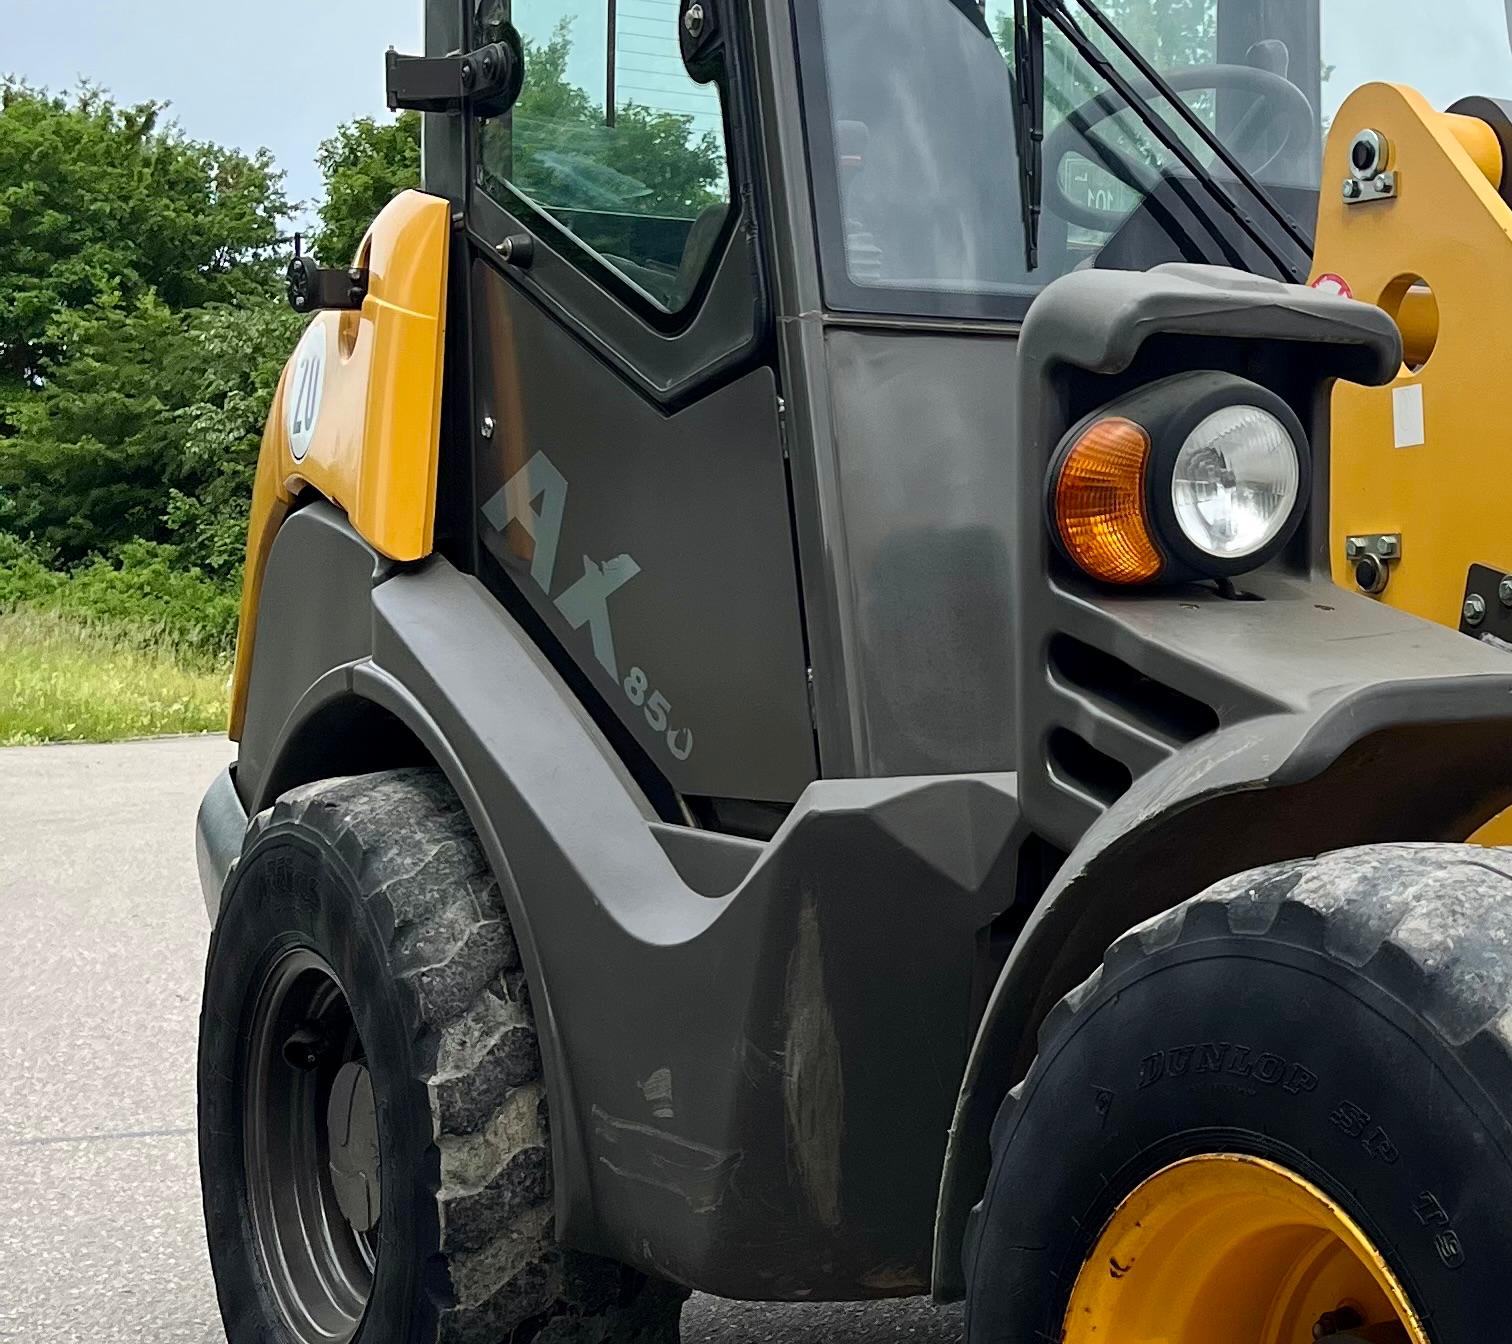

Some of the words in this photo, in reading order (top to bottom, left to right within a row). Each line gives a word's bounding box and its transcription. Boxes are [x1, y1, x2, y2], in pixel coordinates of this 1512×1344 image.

[292, 356, 321, 435] 20
[480, 450, 642, 687] AX
[623, 666, 694, 761] 850
[1135, 1041, 1320, 1095] DUNLOP
[1329, 1099, 1399, 1164] SP
[1410, 1189, 1466, 1269] T9
